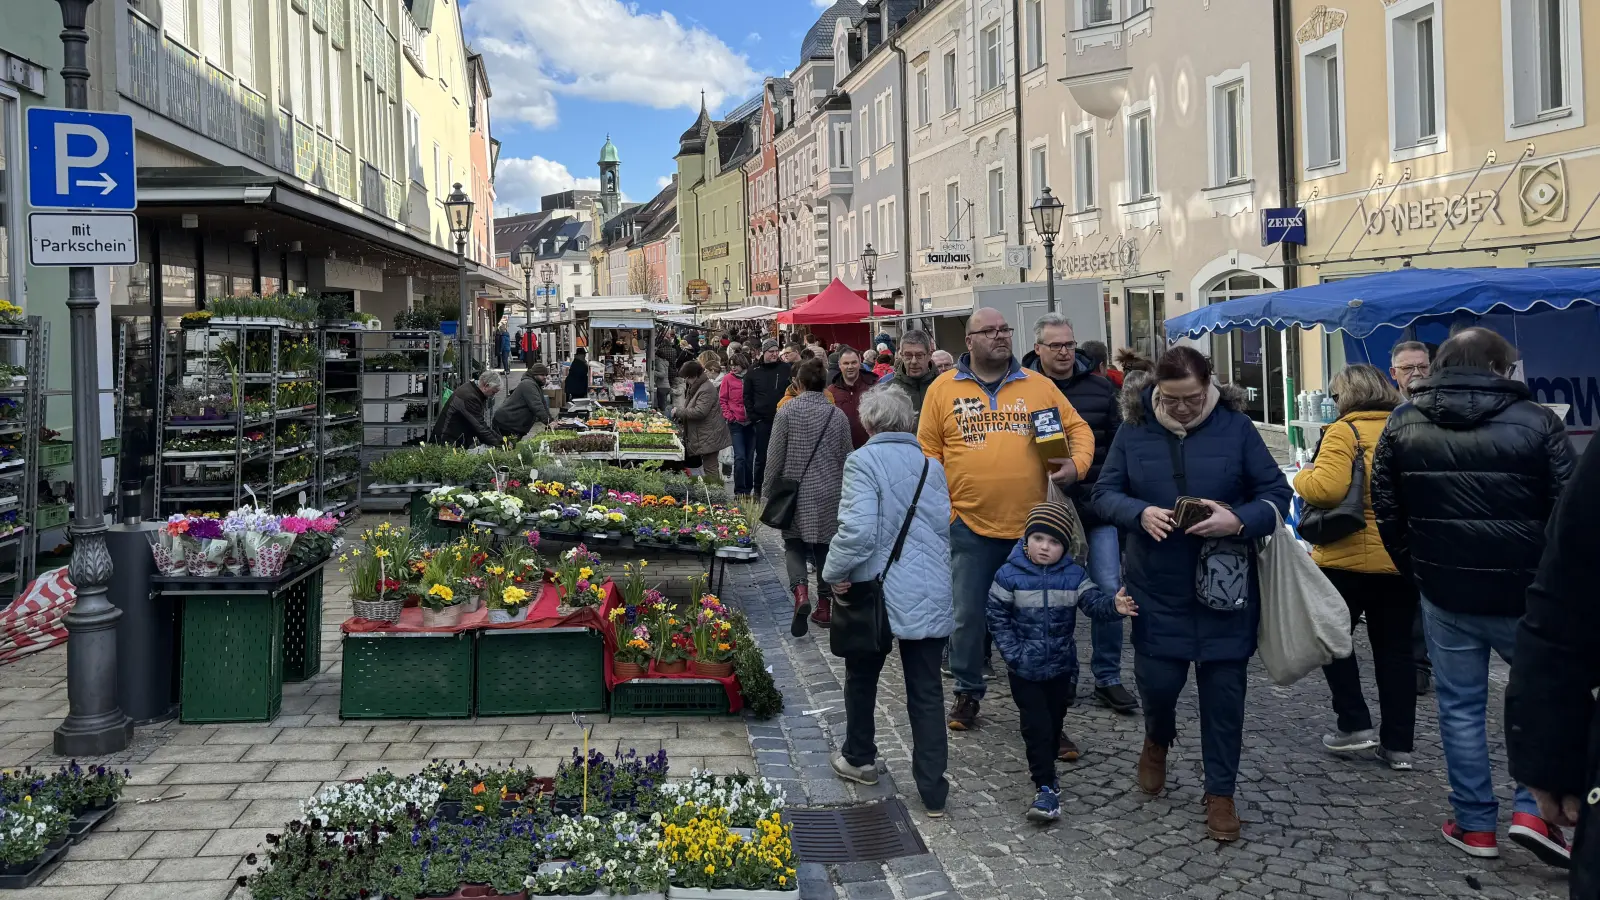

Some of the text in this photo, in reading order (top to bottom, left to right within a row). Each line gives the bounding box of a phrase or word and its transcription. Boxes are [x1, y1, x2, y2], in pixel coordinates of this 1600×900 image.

[54, 122, 109, 194] P
[1268, 217, 1303, 228] ZEISS
[72, 223, 91, 236] mit
[41, 239, 126, 252] Parkschein
[927, 252, 971, 264] tanzhaus
